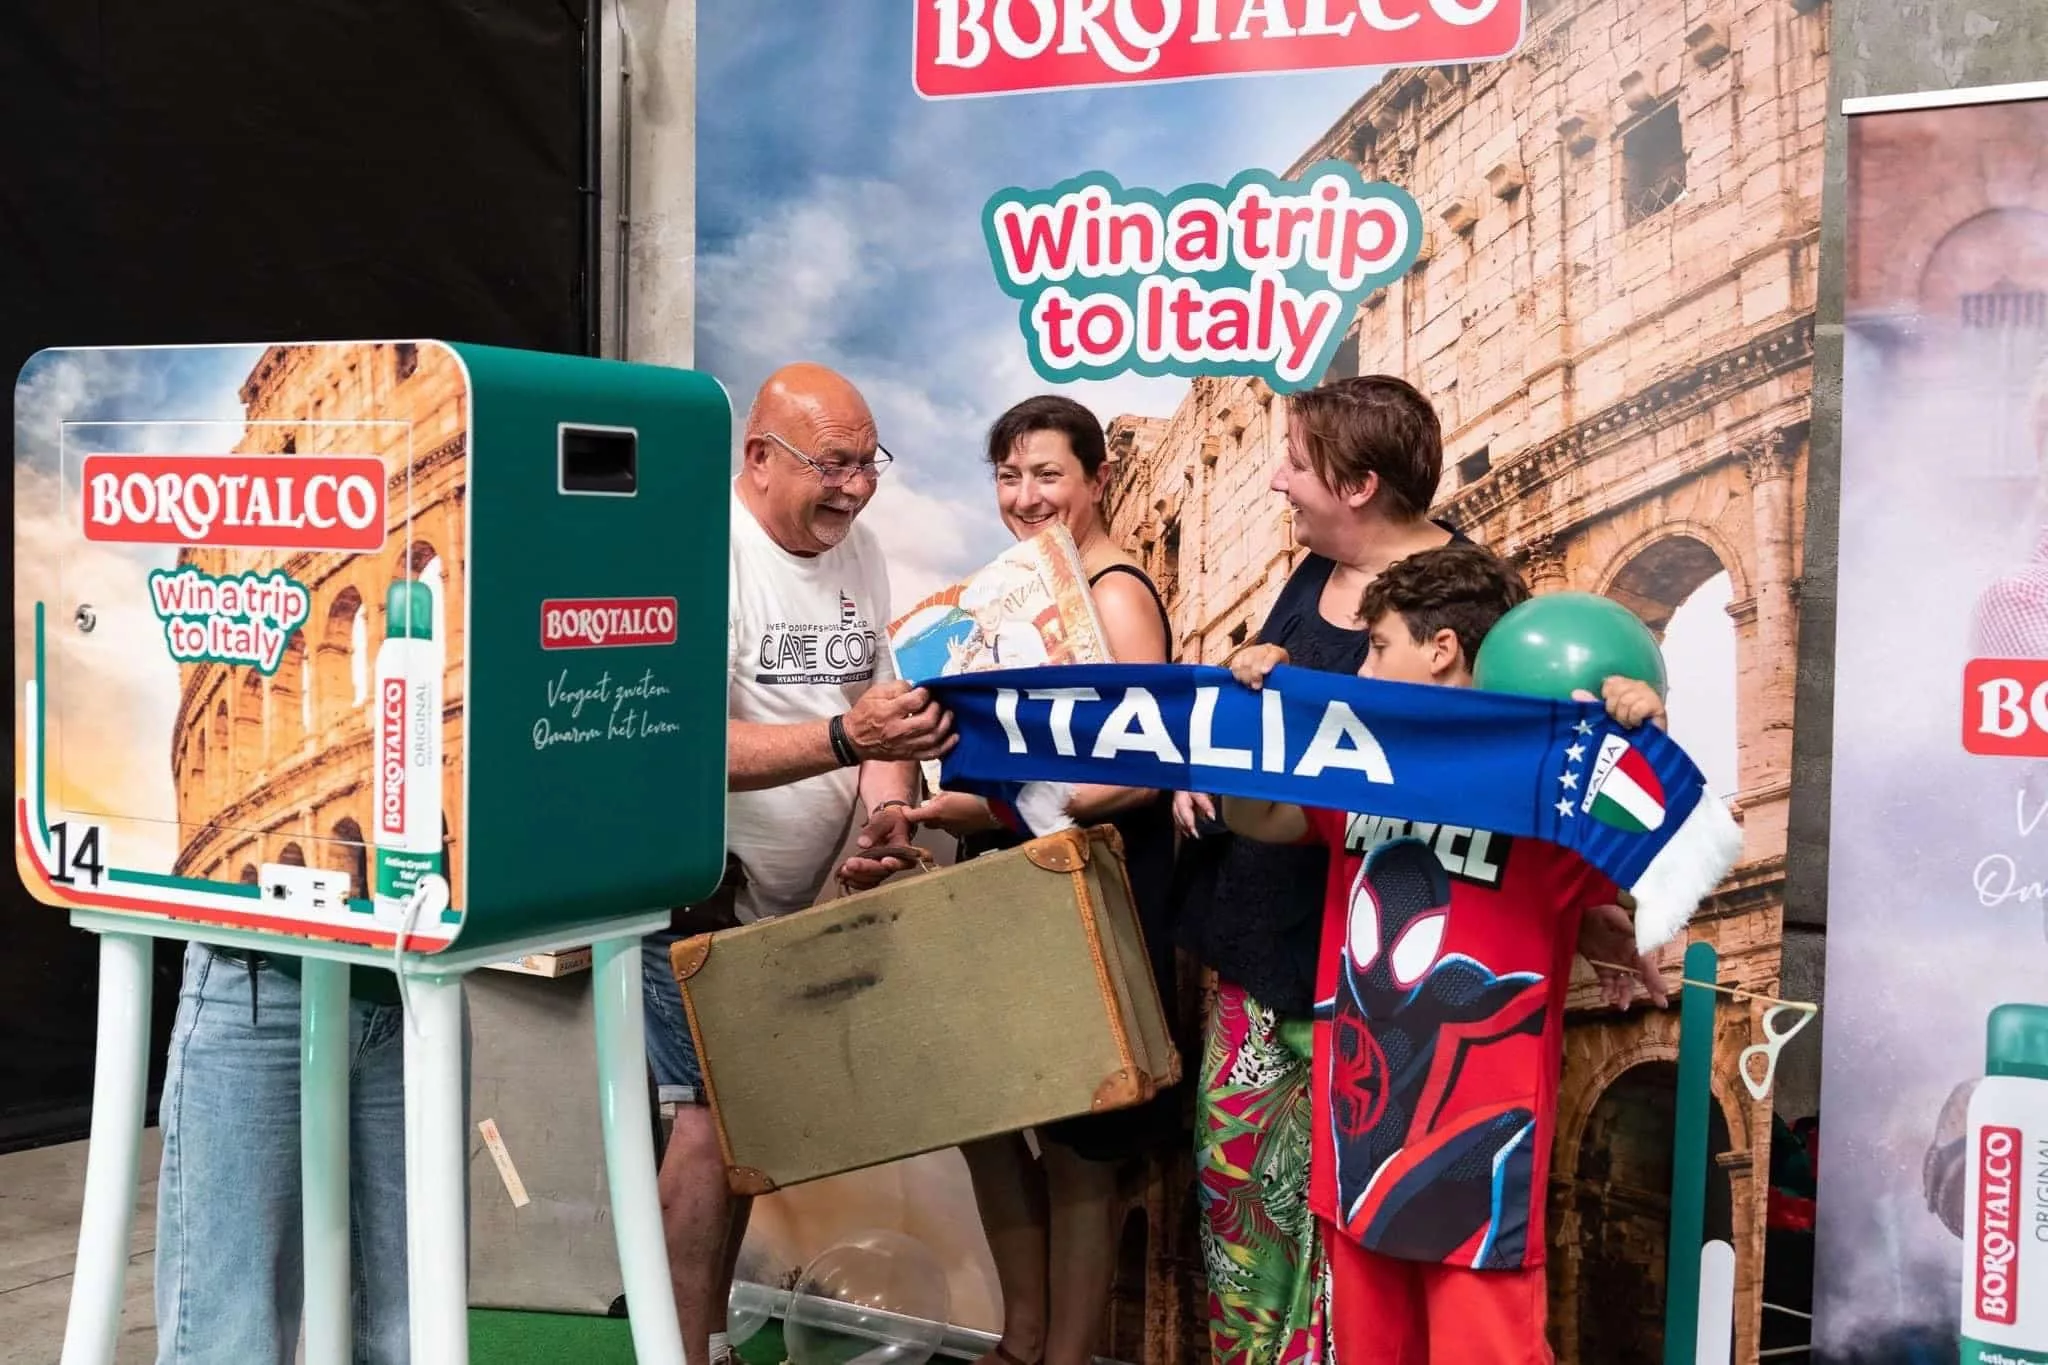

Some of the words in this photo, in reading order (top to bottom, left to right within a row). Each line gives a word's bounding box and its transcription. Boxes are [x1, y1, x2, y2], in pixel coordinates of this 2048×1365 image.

[934, 0, 1497, 73] BOROT
[1002, 196, 1156, 275] Win
[1174, 210, 1219, 262] a
[1237, 186, 1396, 279] trip
[1041, 298, 1125, 358] to
[1146, 279, 1330, 370] Italy
[91, 472, 377, 539] BOROTALCO
[156, 576, 214, 611] Win
[222, 585, 238, 609] a
[245, 578, 302, 624] trip
[546, 606, 673, 644] BOROTALCO
[173, 622, 202, 651] to
[210, 620, 280, 664] Italy
[760, 633, 818, 670] CAPE
[825, 631, 877, 669] COD
[384, 682, 405, 828] BOROTALCO
[414, 681, 427, 767] ORIGINAL
[608, 708, 639, 739] het
[995, 686, 1394, 785] ITALIA
[49, 821, 104, 888] 14
[1345, 811, 1498, 882] AEL
[1981, 1131, 2016, 1318] BOROTALCO
